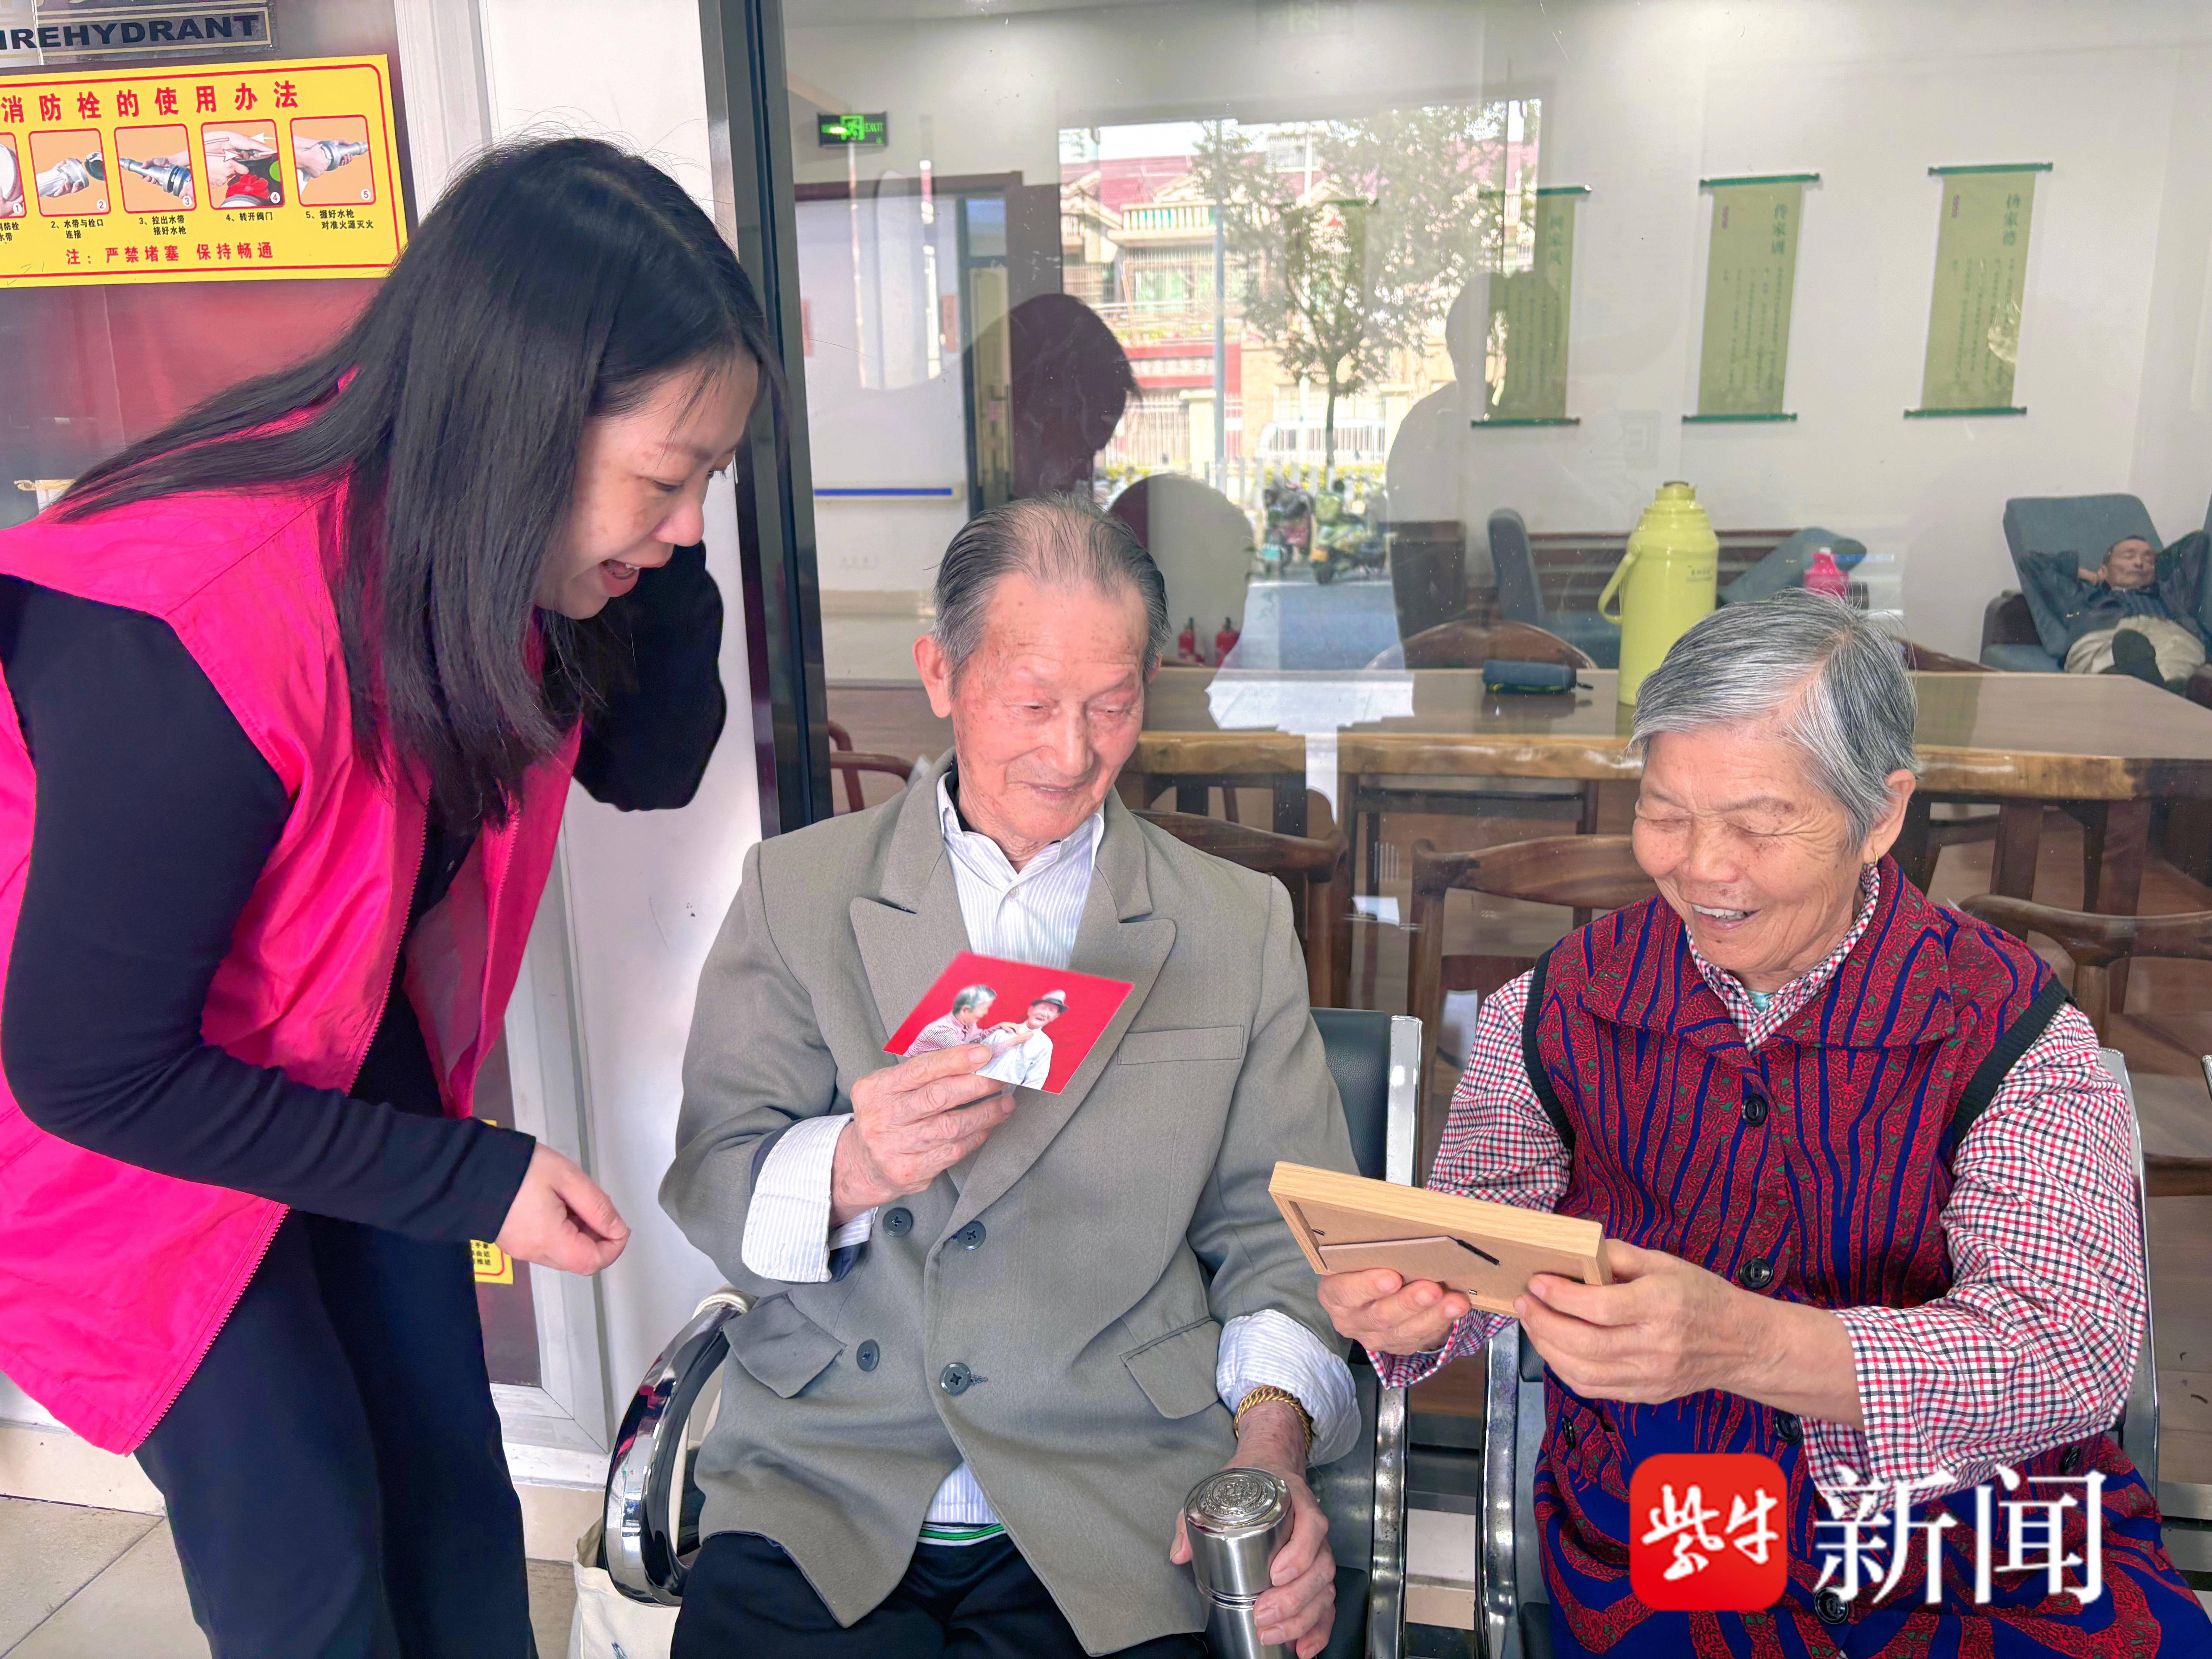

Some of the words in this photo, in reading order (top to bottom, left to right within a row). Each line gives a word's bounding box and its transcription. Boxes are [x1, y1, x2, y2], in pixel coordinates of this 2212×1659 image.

[1, 80, 298, 123] 消防栓的使用办法
[273, 192, 277, 201] 4
[139, 215, 185, 225] 3、拉出水带
[226, 212, 273, 222] 4、转开阀门
[321, 220, 374, 230] 对准火源灭火
[66, 230, 82, 239] 连接
[153, 226, 187, 235] 接好水枪
[197, 242, 273, 260] 保持畅通
